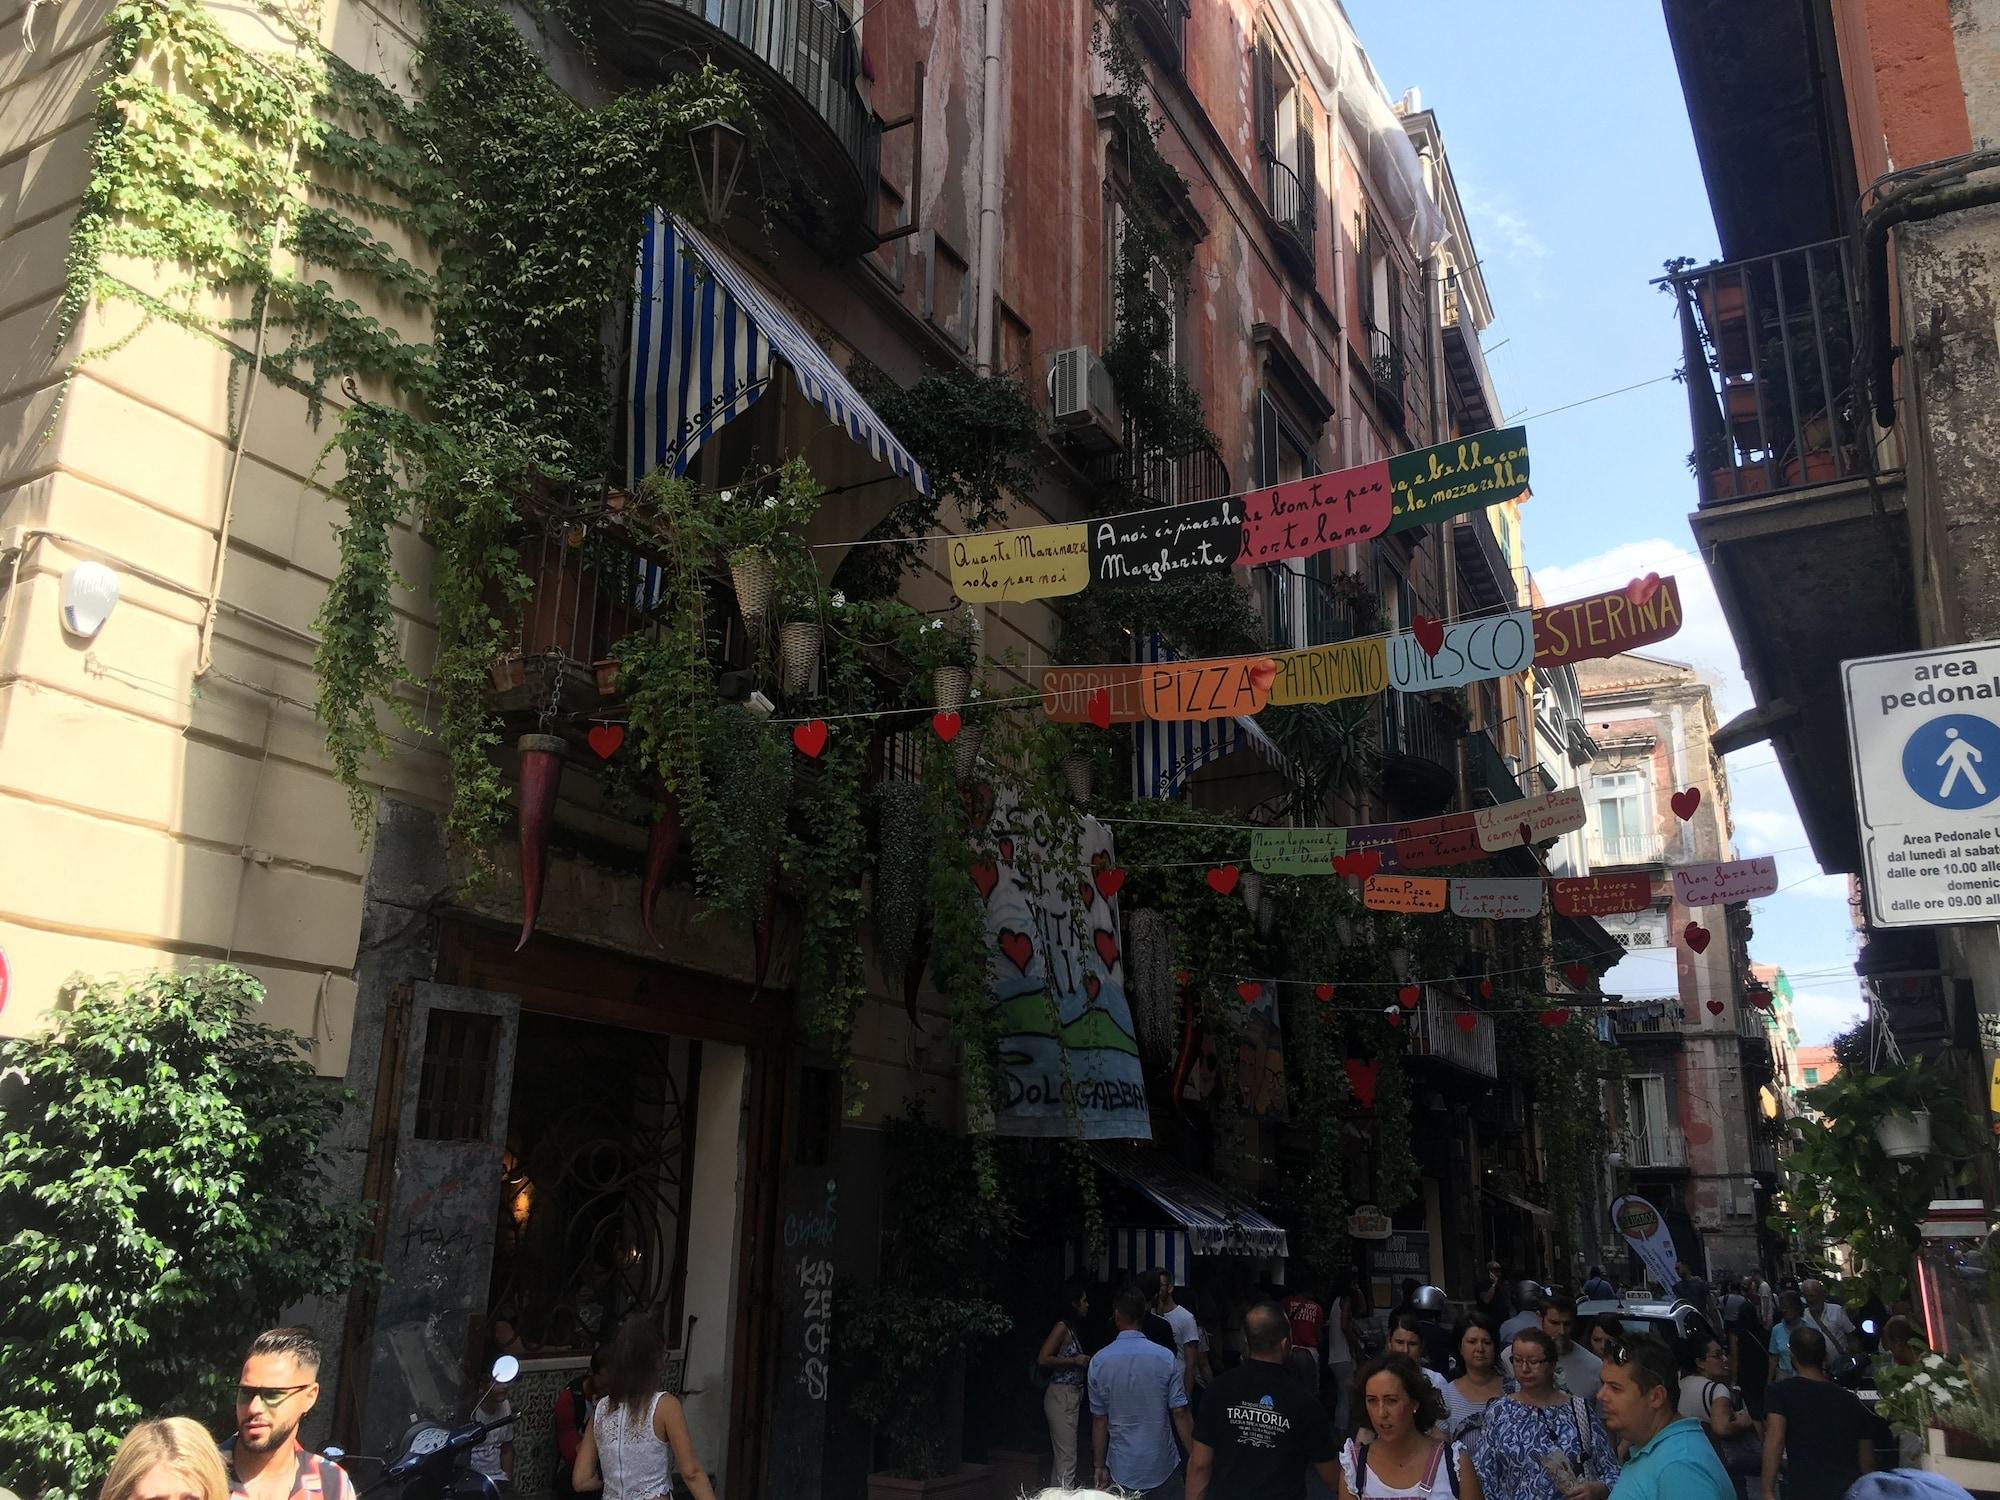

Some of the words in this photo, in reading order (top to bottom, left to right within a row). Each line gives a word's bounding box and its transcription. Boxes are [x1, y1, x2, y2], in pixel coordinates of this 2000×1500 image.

[1428, 441, 1496, 482] bella
[1344, 482, 1383, 512] per
[1407, 489, 1427, 513] la
[1221, 502, 1241, 526] la
[1100, 540, 1228, 581] Margherita
[963, 567, 998, 588] solo
[1002, 574, 1034, 600] per
[1039, 568, 1067, 585] noi
[1531, 582, 1680, 659] ESTERINA
[1269, 642, 1385, 699] PATRIMONIO
[1914, 660, 1978, 681] area
[1153, 665, 1257, 713] PIZZA
[1903, 834, 1932, 845] Area
[1935, 828, 1991, 842] Pedonale
[1888, 851, 1906, 862] dal
[1950, 846, 1961, 858] al
[1887, 867, 1916, 878] dalle
[1920, 867, 1940, 876] ore
[1943, 862, 1977, 874] 10.00
[1891, 900, 1920, 911] dalle
[1924, 899, 1944, 909] ore
[1948, 895, 1982, 907] 09.00
[1226, 1407, 1290, 1430] TRATTORIA
